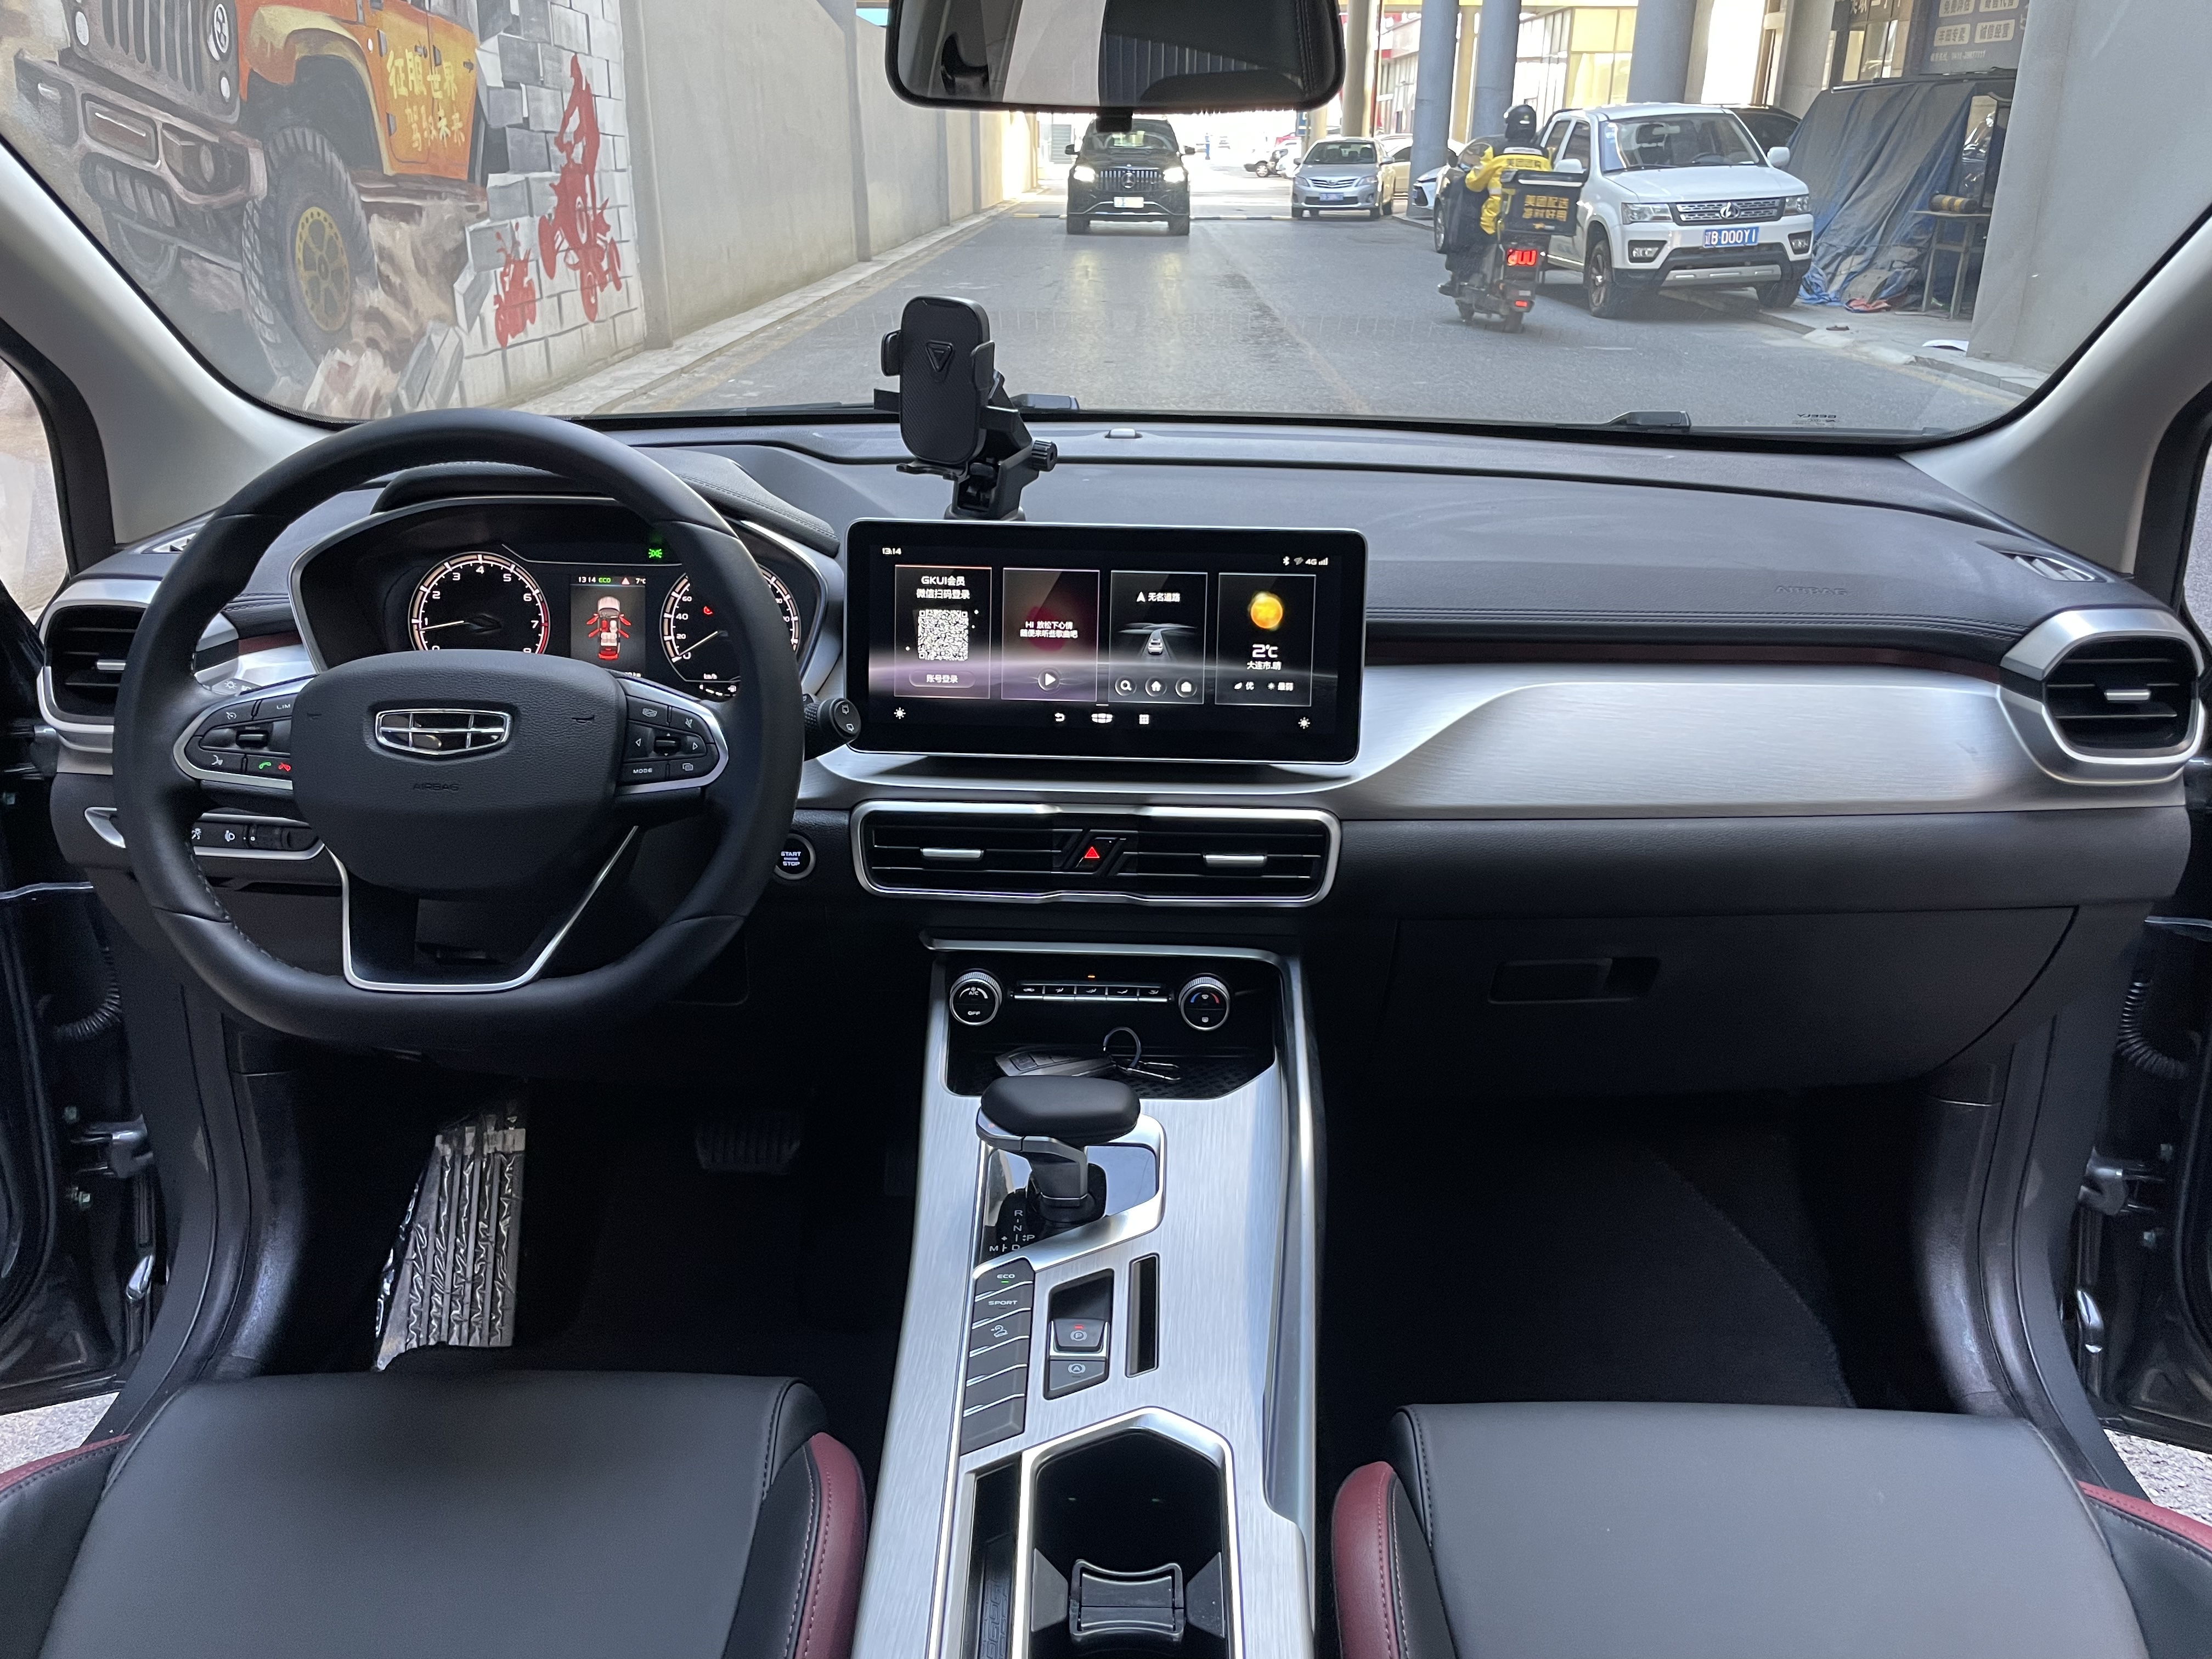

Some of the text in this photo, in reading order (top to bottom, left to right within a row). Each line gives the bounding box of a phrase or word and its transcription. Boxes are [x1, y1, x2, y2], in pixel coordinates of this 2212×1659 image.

[386, 49, 459, 101] 征服世界
[476, 566, 484, 574] 4
[453, 572, 461, 581] 3
[503, 573, 512, 582] 5
[432, 591, 441, 599] 2
[523, 593, 532, 602] 6
[916, 588, 970, 599] 微信扫码登录
[424, 617, 428, 625] 1
[531, 620, 539, 629] 7
[926, 674, 958, 684] 账号登录
